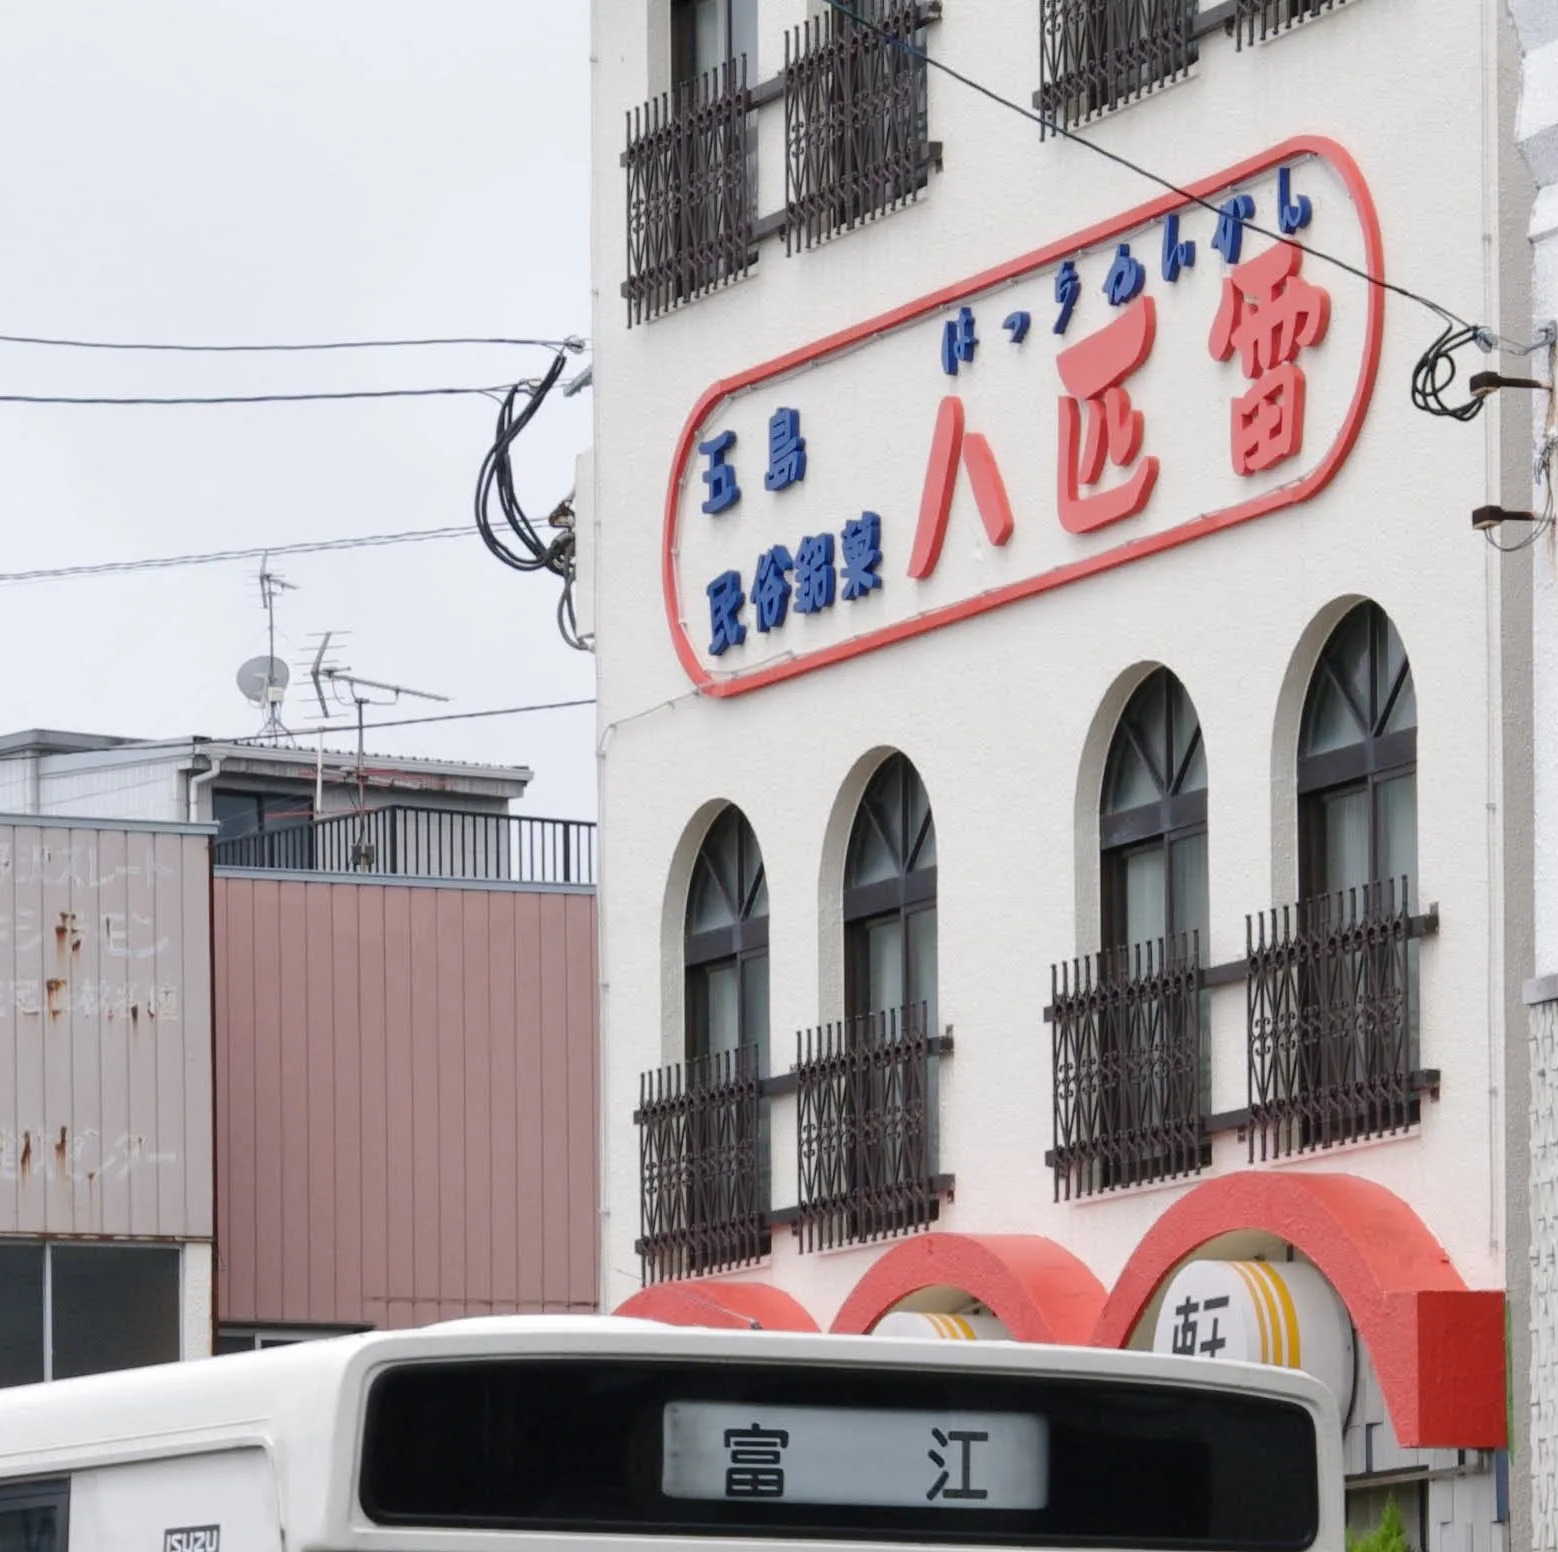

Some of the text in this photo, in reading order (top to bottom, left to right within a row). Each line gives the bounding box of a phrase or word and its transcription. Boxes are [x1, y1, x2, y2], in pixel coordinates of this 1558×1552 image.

[698, 407, 807, 515] 五島
[907, 238, 1331, 580] 八匹雷
[706, 511, 883, 656] 民俗銘菓
[724, 1422, 989, 1501] 富江
